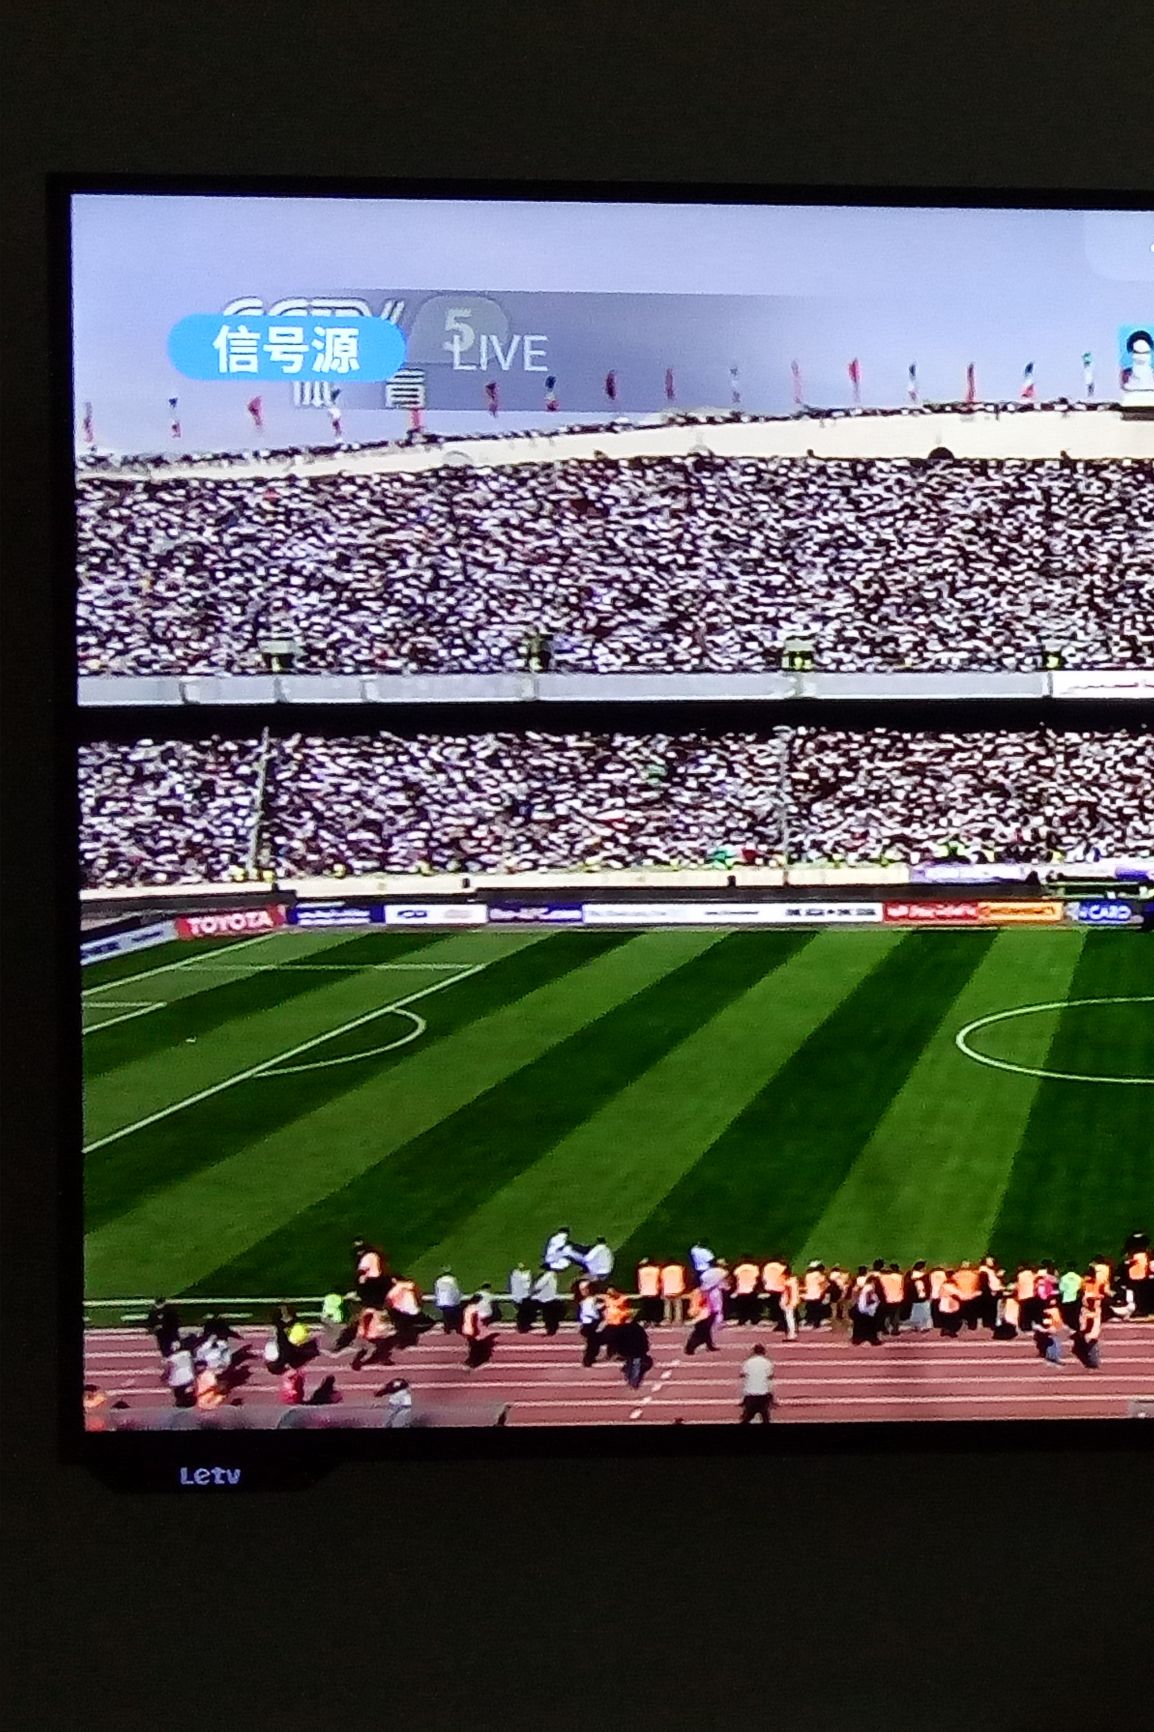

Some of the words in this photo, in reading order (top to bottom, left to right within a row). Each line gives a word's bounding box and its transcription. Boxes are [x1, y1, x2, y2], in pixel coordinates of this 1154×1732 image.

[213, 324, 361, 374] 信号源
[453, 334, 549, 371] LIVE
